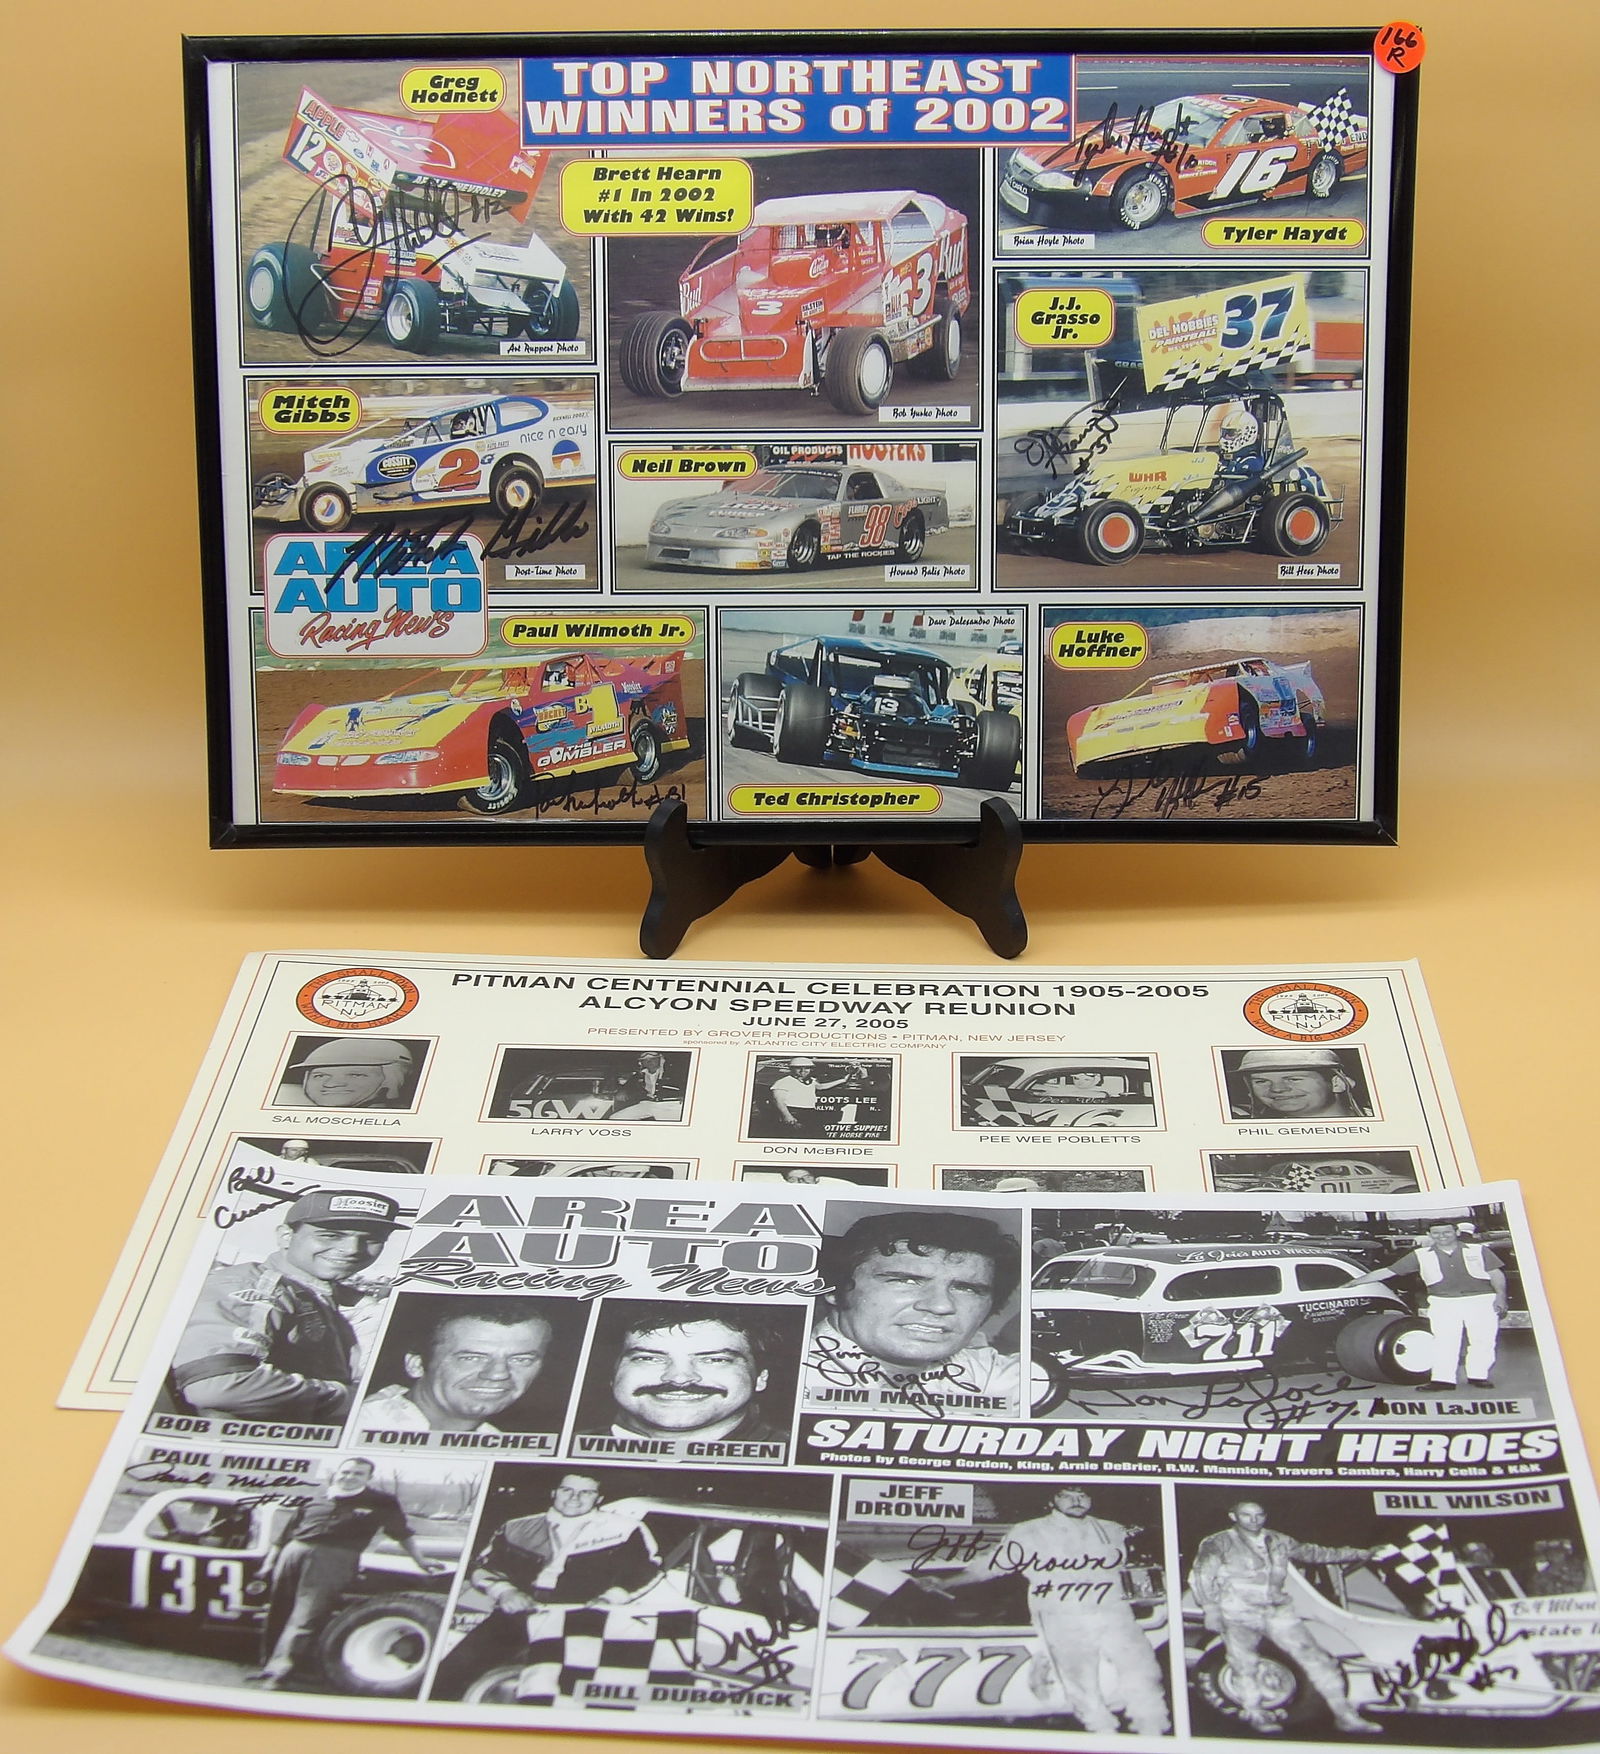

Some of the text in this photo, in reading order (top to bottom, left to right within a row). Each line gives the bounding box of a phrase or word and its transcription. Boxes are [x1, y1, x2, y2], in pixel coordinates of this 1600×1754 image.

[1380, 26, 1419, 49] 166
[1386, 46, 1407, 68] R
[430, 75, 480, 91] Greg
[553, 58, 1039, 96] TOP NORTHEAST
[411, 89, 498, 104] Hodnett
[303, 100, 346, 141] APPLE
[525, 97, 1068, 135] WINNERS of 2002
[290, 123, 327, 172] 12
[593, 166, 722, 182] Brett Hearn
[1208, 147, 1298, 200] 16
[598, 187, 715, 202] #1 In 2002
[584, 207, 735, 224] With 42 Wins!
[1013, 235, 1085, 248] Brian Hoyle Photo
[1224, 225, 1347, 242] Tyler Haydt
[913, 252, 933, 317] 3
[751, 300, 783, 316] 3
[1049, 297, 1081, 311] J.J.
[1031, 311, 1101, 326] Grasso
[1220, 284, 1297, 349] 37
[1051, 325, 1079, 340] Jr.
[1149, 314, 1219, 340] DEL HOBBIES
[1155, 328, 1217, 348] PAINTBALL
[272, 395, 351, 410] Mitch
[274, 409, 351, 424] Gibbs
[519, 423, 588, 444] nice n easy
[772, 446, 843, 455] OIL PRODUCTS
[438, 448, 481, 492] 2
[632, 458, 747, 472] Neil Brown
[1128, 470, 1168, 483] WHR
[859, 504, 893, 548] 98
[861, 550, 896, 558] ROCKIES
[889, 566, 919, 578] Howard
[944, 566, 966, 578] Photo
[273, 577, 482, 614] AUTO
[299, 604, 455, 653] Racing News
[928, 615, 1016, 627] Dave Dalesandro Photo
[513, 622, 685, 639] Paul Wilmoth Jr.
[1075, 631, 1125, 644] Luke
[1058, 644, 1143, 658] Hoffner
[874, 697, 899, 713] 13
[589, 721, 621, 734] WILMOTH
[753, 793, 920, 809] Ted Christopher
[452, 974, 1210, 999] PITMAN CENTENNIAL CELEBRATION 1905-2005
[579, 996, 1077, 1017] ALCYON SPEEDWAY REUNION
[742, 1017, 909, 1030] JUNE 27, 2005
[587, 1027, 679, 1037] PRESENTED
[707, 1030, 772, 1039] GROVER
[776, 1031, 888, 1042] PRODUCTIONS
[902, 1034, 963, 1044] PITMAN,
[967, 1034, 1002, 1042] NEW
[1005, 1034, 1067, 1043] JERSEY
[683, 1039, 728, 1047] sponsored
[815, 1096, 850, 1104] TOOTS
[272, 1114, 402, 1127] SAL MOSCHELLA
[530, 1127, 633, 1138] LARRY VOSS
[979, 1134, 1141, 1144] PEE WEE POBLETTS
[1238, 1126, 1371, 1137] PHIL GEMENDEN
[763, 1146, 875, 1157] DON McBRIDE
[415, 1195, 823, 1238] AREA
[413, 1231, 822, 1276] AUTO
[392, 1257, 837, 1301] Racing News
[1297, 1298, 1360, 1313] TUCCINARDI
[1195, 1320, 1277, 1361] 711
[816, 1388, 1007, 1411] JIM MAGUIRE
[1437, 1400, 1521, 1415] LaJOIE
[155, 1416, 335, 1442] BOB CICCONI
[362, 1430, 553, 1450] TOM MICHEL
[579, 1437, 781, 1459] VINNIE GREEN
[807, 1419, 1560, 1463] SATURDAY NIGHT HEROES
[149, 1448, 311, 1473] PAUL MILLER
[820, 1451, 1542, 1480] Photos by George Gordon, King, Arnie DeBrier, R.W. Mannion, Travers Cambra, Harry Cella & K&K
[878, 1484, 944, 1501] JEFF
[1385, 1488, 1552, 1511] BILL WILSON
[854, 1501, 966, 1520] DROWN
[131, 1549, 245, 1619] 133
[1030, 1581, 1115, 1605] #777
[842, 1645, 1033, 1711] 777
[584, 1683, 795, 1708] BILL DUBOVICK
